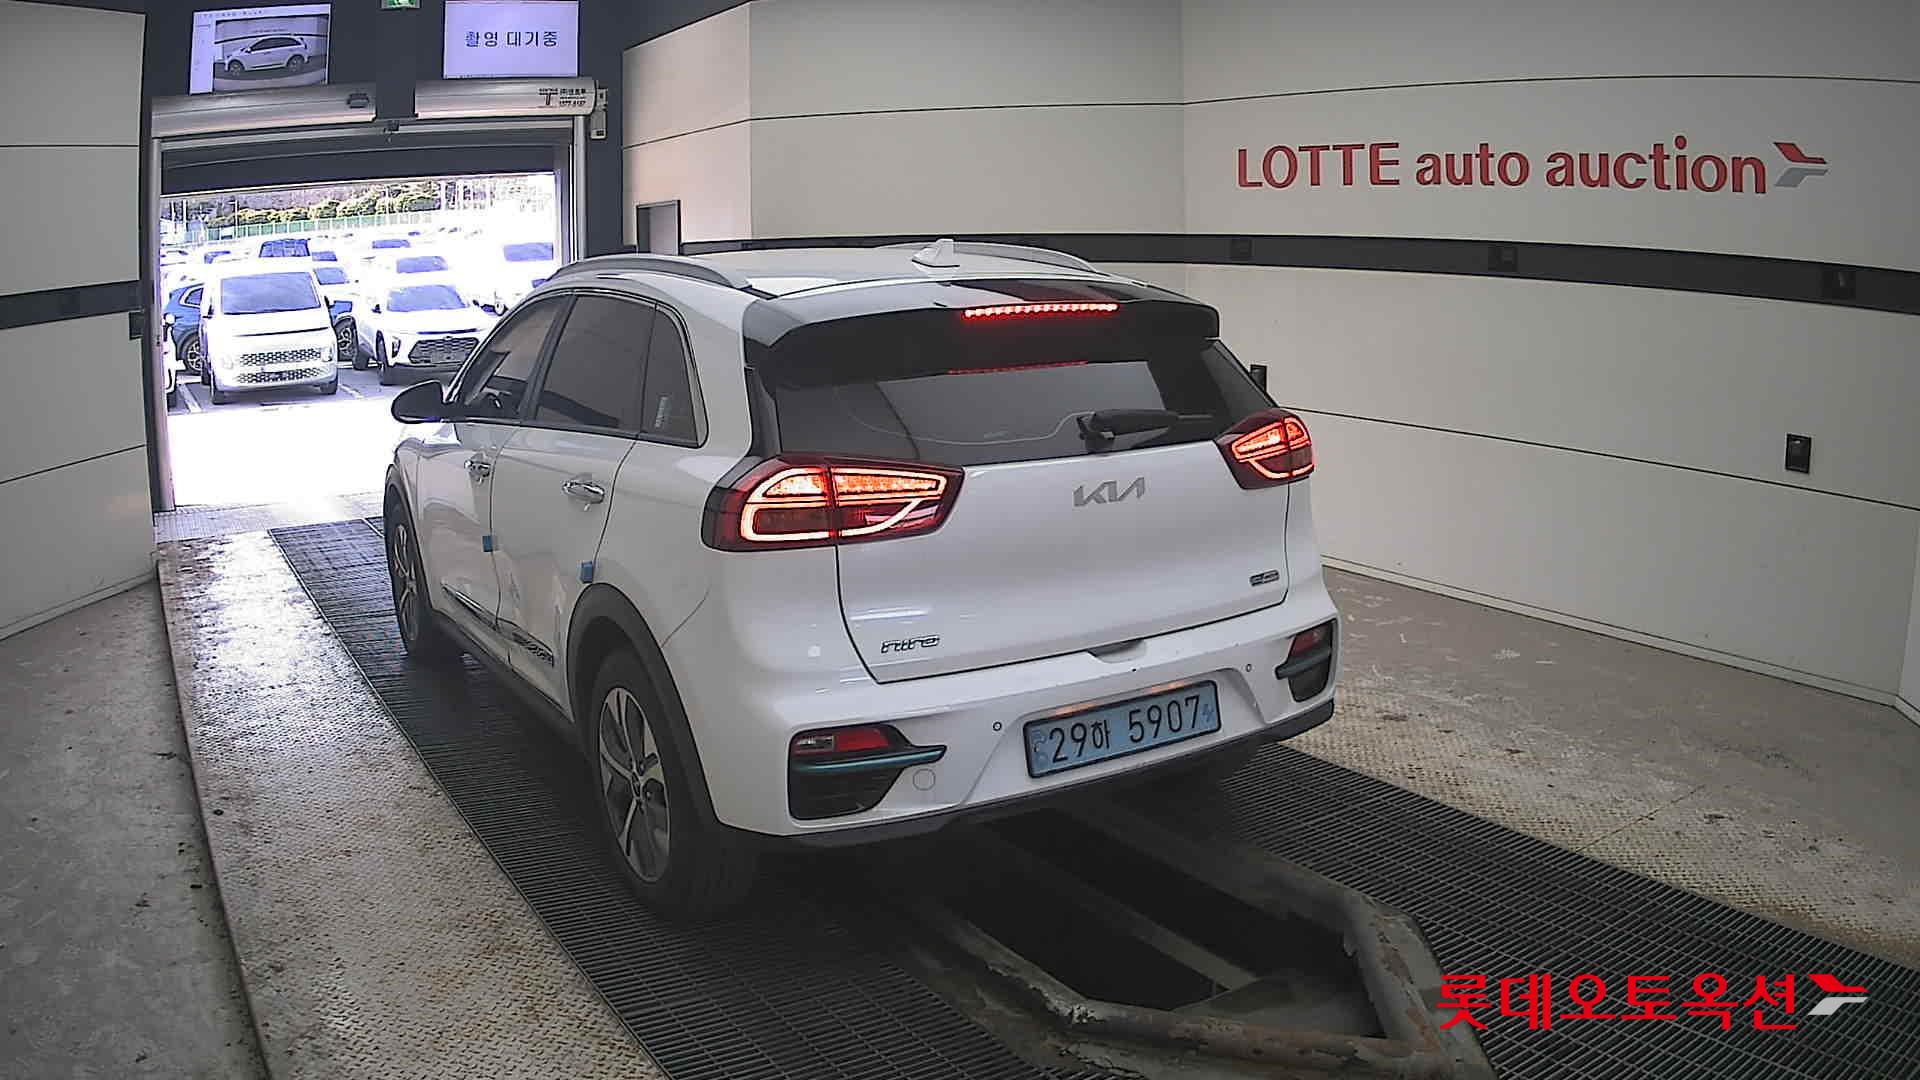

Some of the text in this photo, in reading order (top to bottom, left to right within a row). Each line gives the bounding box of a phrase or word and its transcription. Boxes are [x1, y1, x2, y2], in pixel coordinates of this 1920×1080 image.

[1237, 136, 1766, 194] LOTTE auto auction
[1049, 695, 1200, 764] 29하 5907
